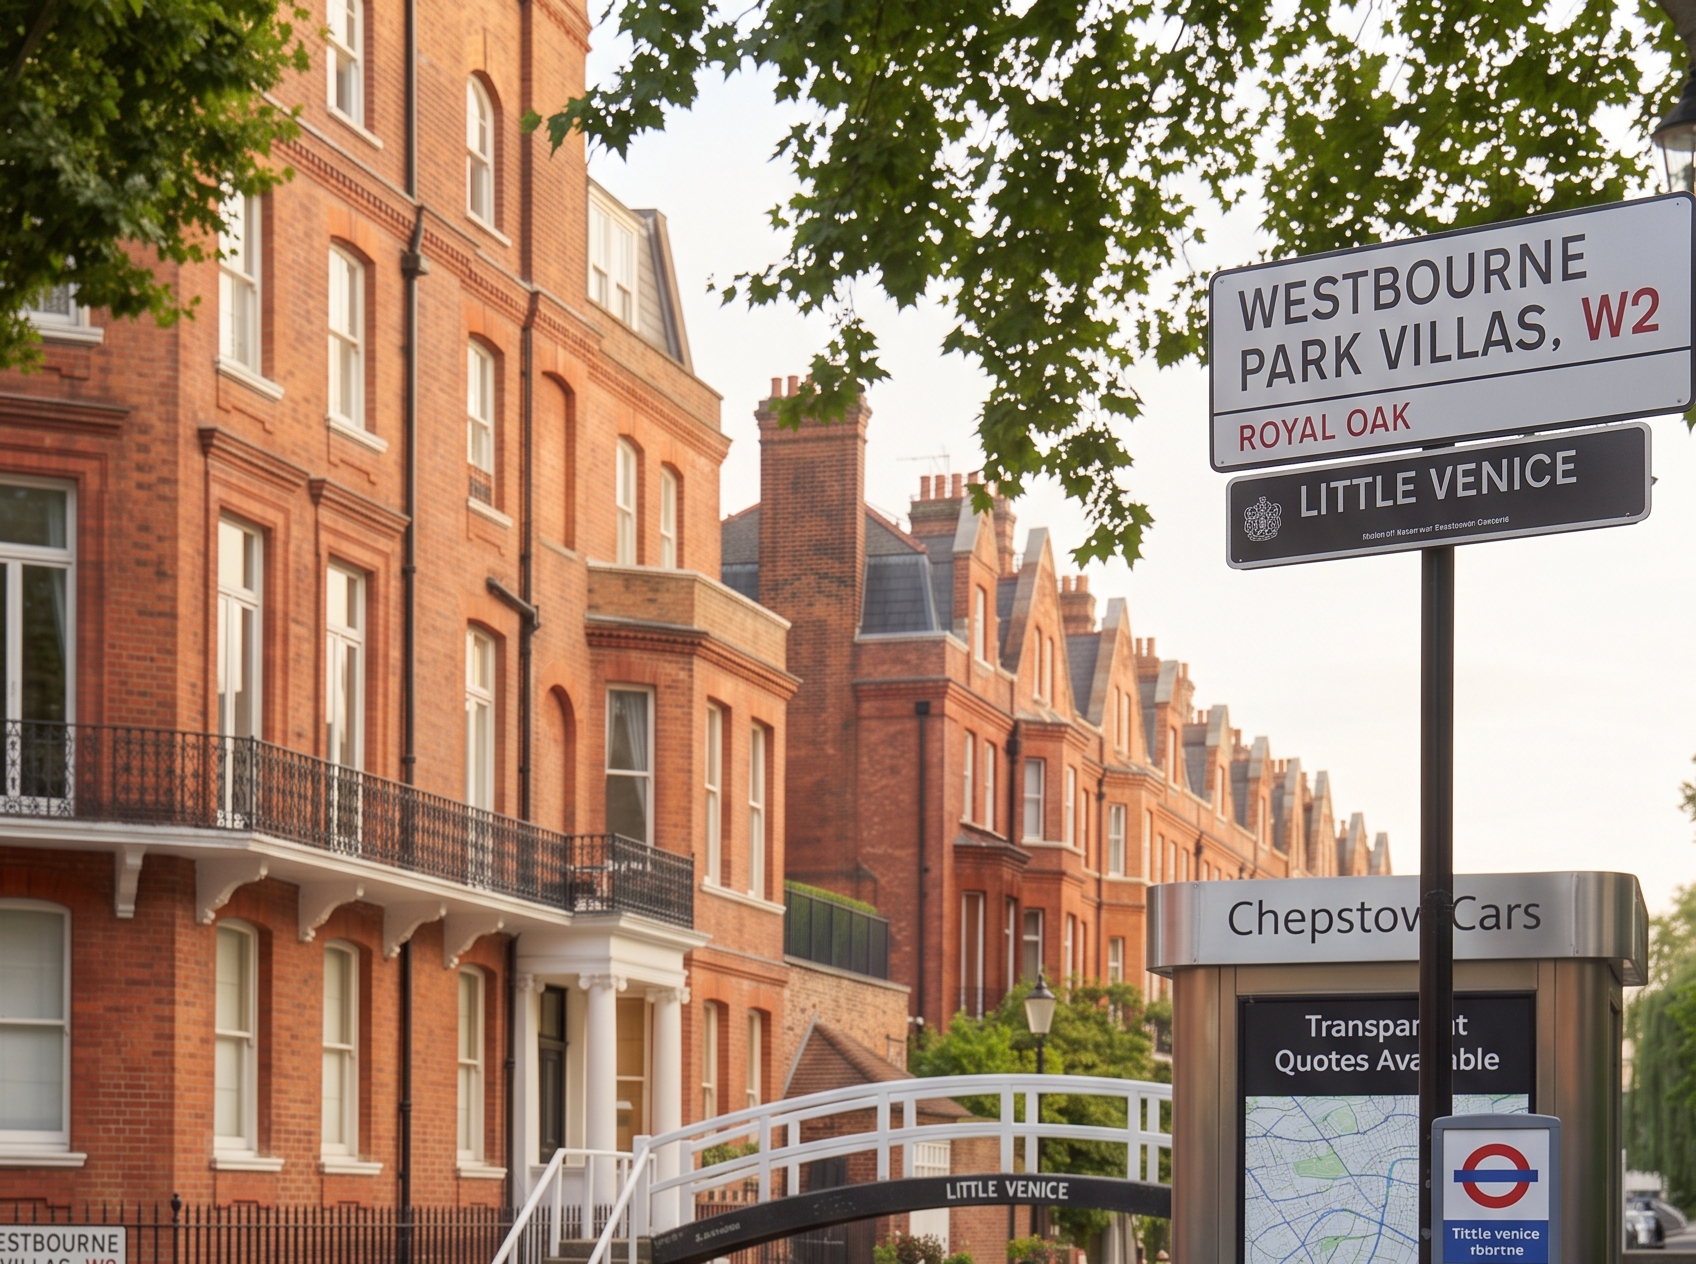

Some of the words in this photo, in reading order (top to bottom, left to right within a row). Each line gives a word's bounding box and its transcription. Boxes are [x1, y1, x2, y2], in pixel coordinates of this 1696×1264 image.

[1238, 233, 1587, 332] WESTBOURNE
[1241, 332, 1362, 392] PARK
[1379, 304, 1562, 371] VILLAS,
[1582, 286, 1660, 342] W2
[1238, 413, 1336, 452] ROYAL
[1346, 402, 1411, 437] OAK
[1299, 471, 1417, 518] LITTLE
[1429, 449, 1577, 500] VENICE
[1453, 895, 1542, 931] Cars
[1305, 1015, 1469, 1043] Transpart
[1275, 1049, 1370, 1076] Quotes
[1376, 1047, 1500, 1071] Avable
[946, 1180, 998, 1200] LITTLE
[1005, 1180, 1069, 1200] VENICE
[1452, 1227, 1491, 1240] Tittle
[1494, 1227, 1540, 1240] venice
